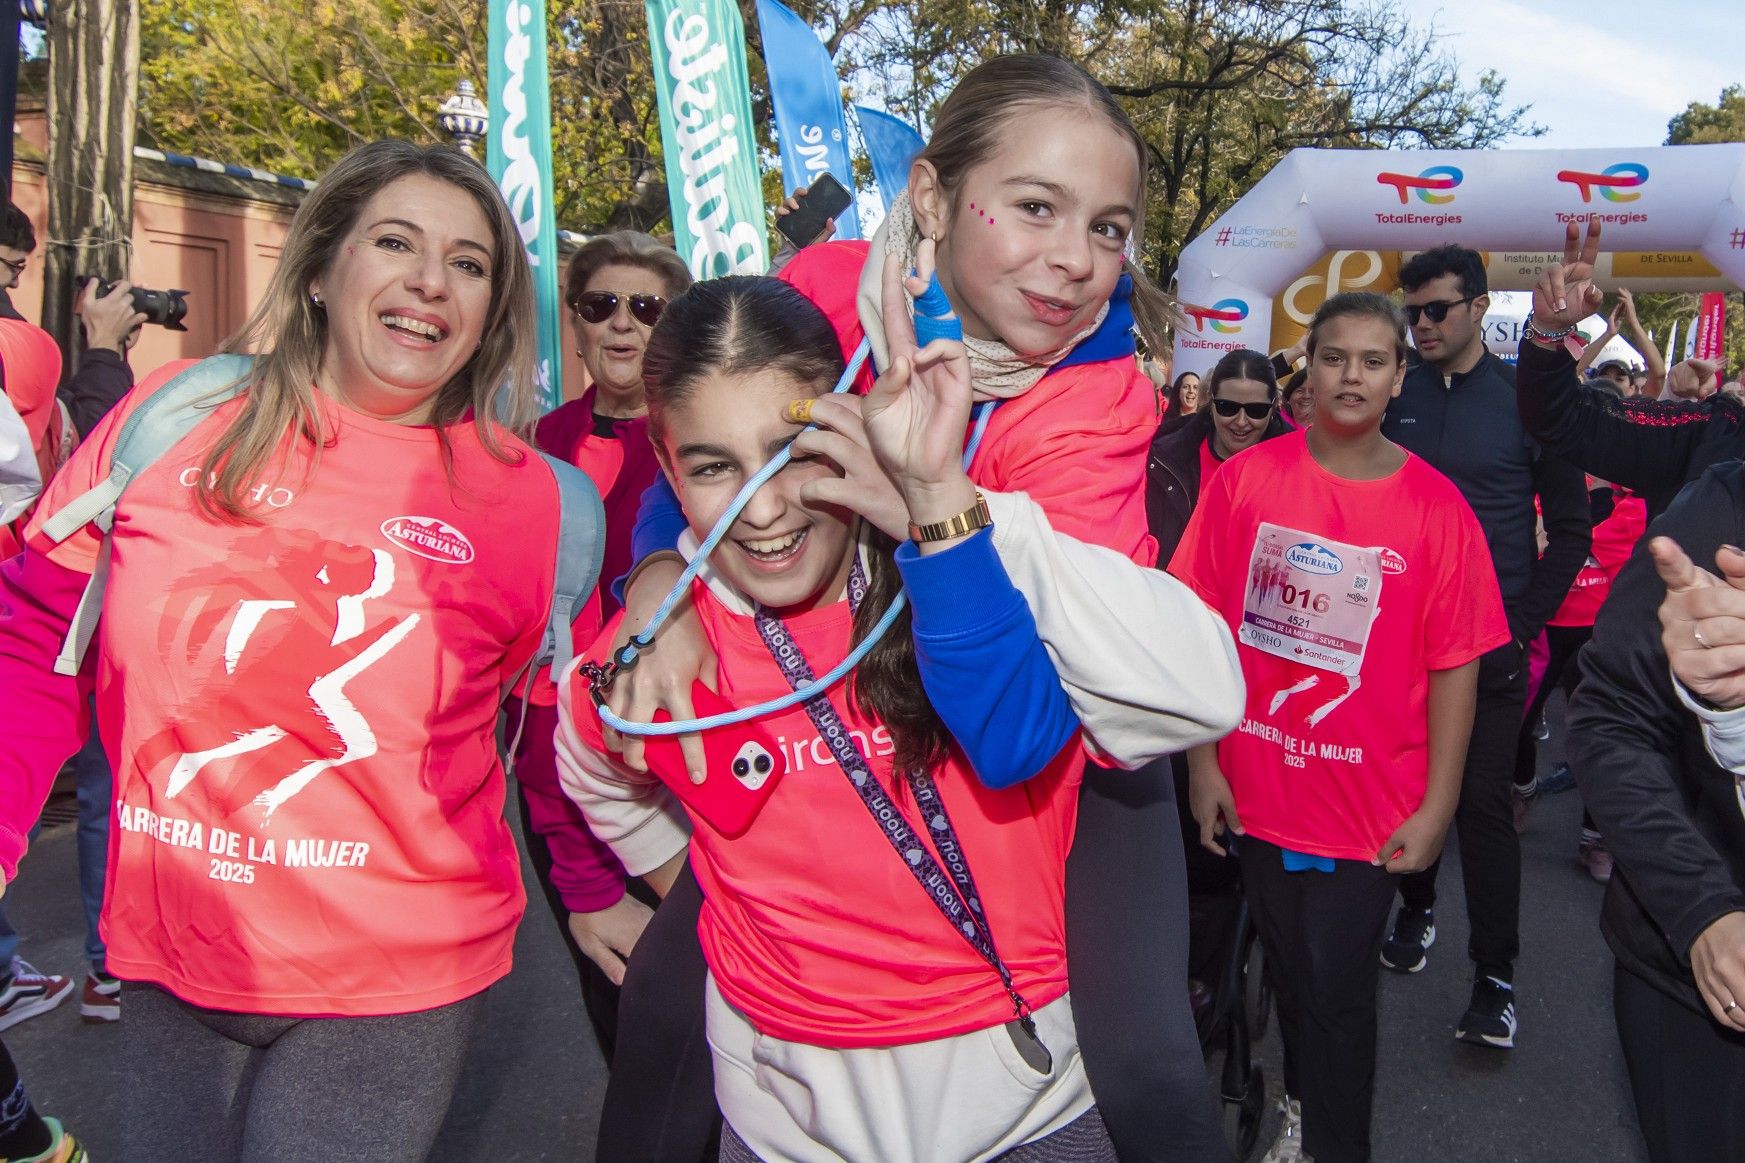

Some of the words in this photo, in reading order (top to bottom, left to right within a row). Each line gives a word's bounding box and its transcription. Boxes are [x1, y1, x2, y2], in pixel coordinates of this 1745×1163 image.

[1375, 213, 1462, 225] TotalEnergies
[1504, 254, 1544, 263] Instituto
[1641, 255, 1652, 263] DE
[1519, 266, 1531, 275] de
[1481, 322, 1522, 342] YSH
[1181, 339, 1246, 351] TotalEnergies
[387, 522, 467, 561] ASTURIANA
[1288, 549, 1338, 572] ASTURIANA
[1381, 558, 1403, 571] RIANA
[1281, 585, 1331, 613] 016
[1287, 614, 1310, 628] 4521
[1251, 629, 1282, 648] OYSHO
[1255, 617, 1277, 630] CARRERA
[1293, 628, 1315, 641] MUJER
[1319, 636, 1344, 648] SEVILLA
[1303, 648, 1346, 666] Santander
[1239, 718, 1283, 746] CARRERA
[1284, 735, 1297, 753] DE
[1301, 740, 1316, 757] LA
[1320, 743, 1363, 764] MUJER
[1284, 753, 1305, 768] 2025
[208, 827, 241, 858] DE
[247, 837, 276, 865] LA
[284, 839, 370, 868] MUJER
[208, 858, 255, 884] 2025
